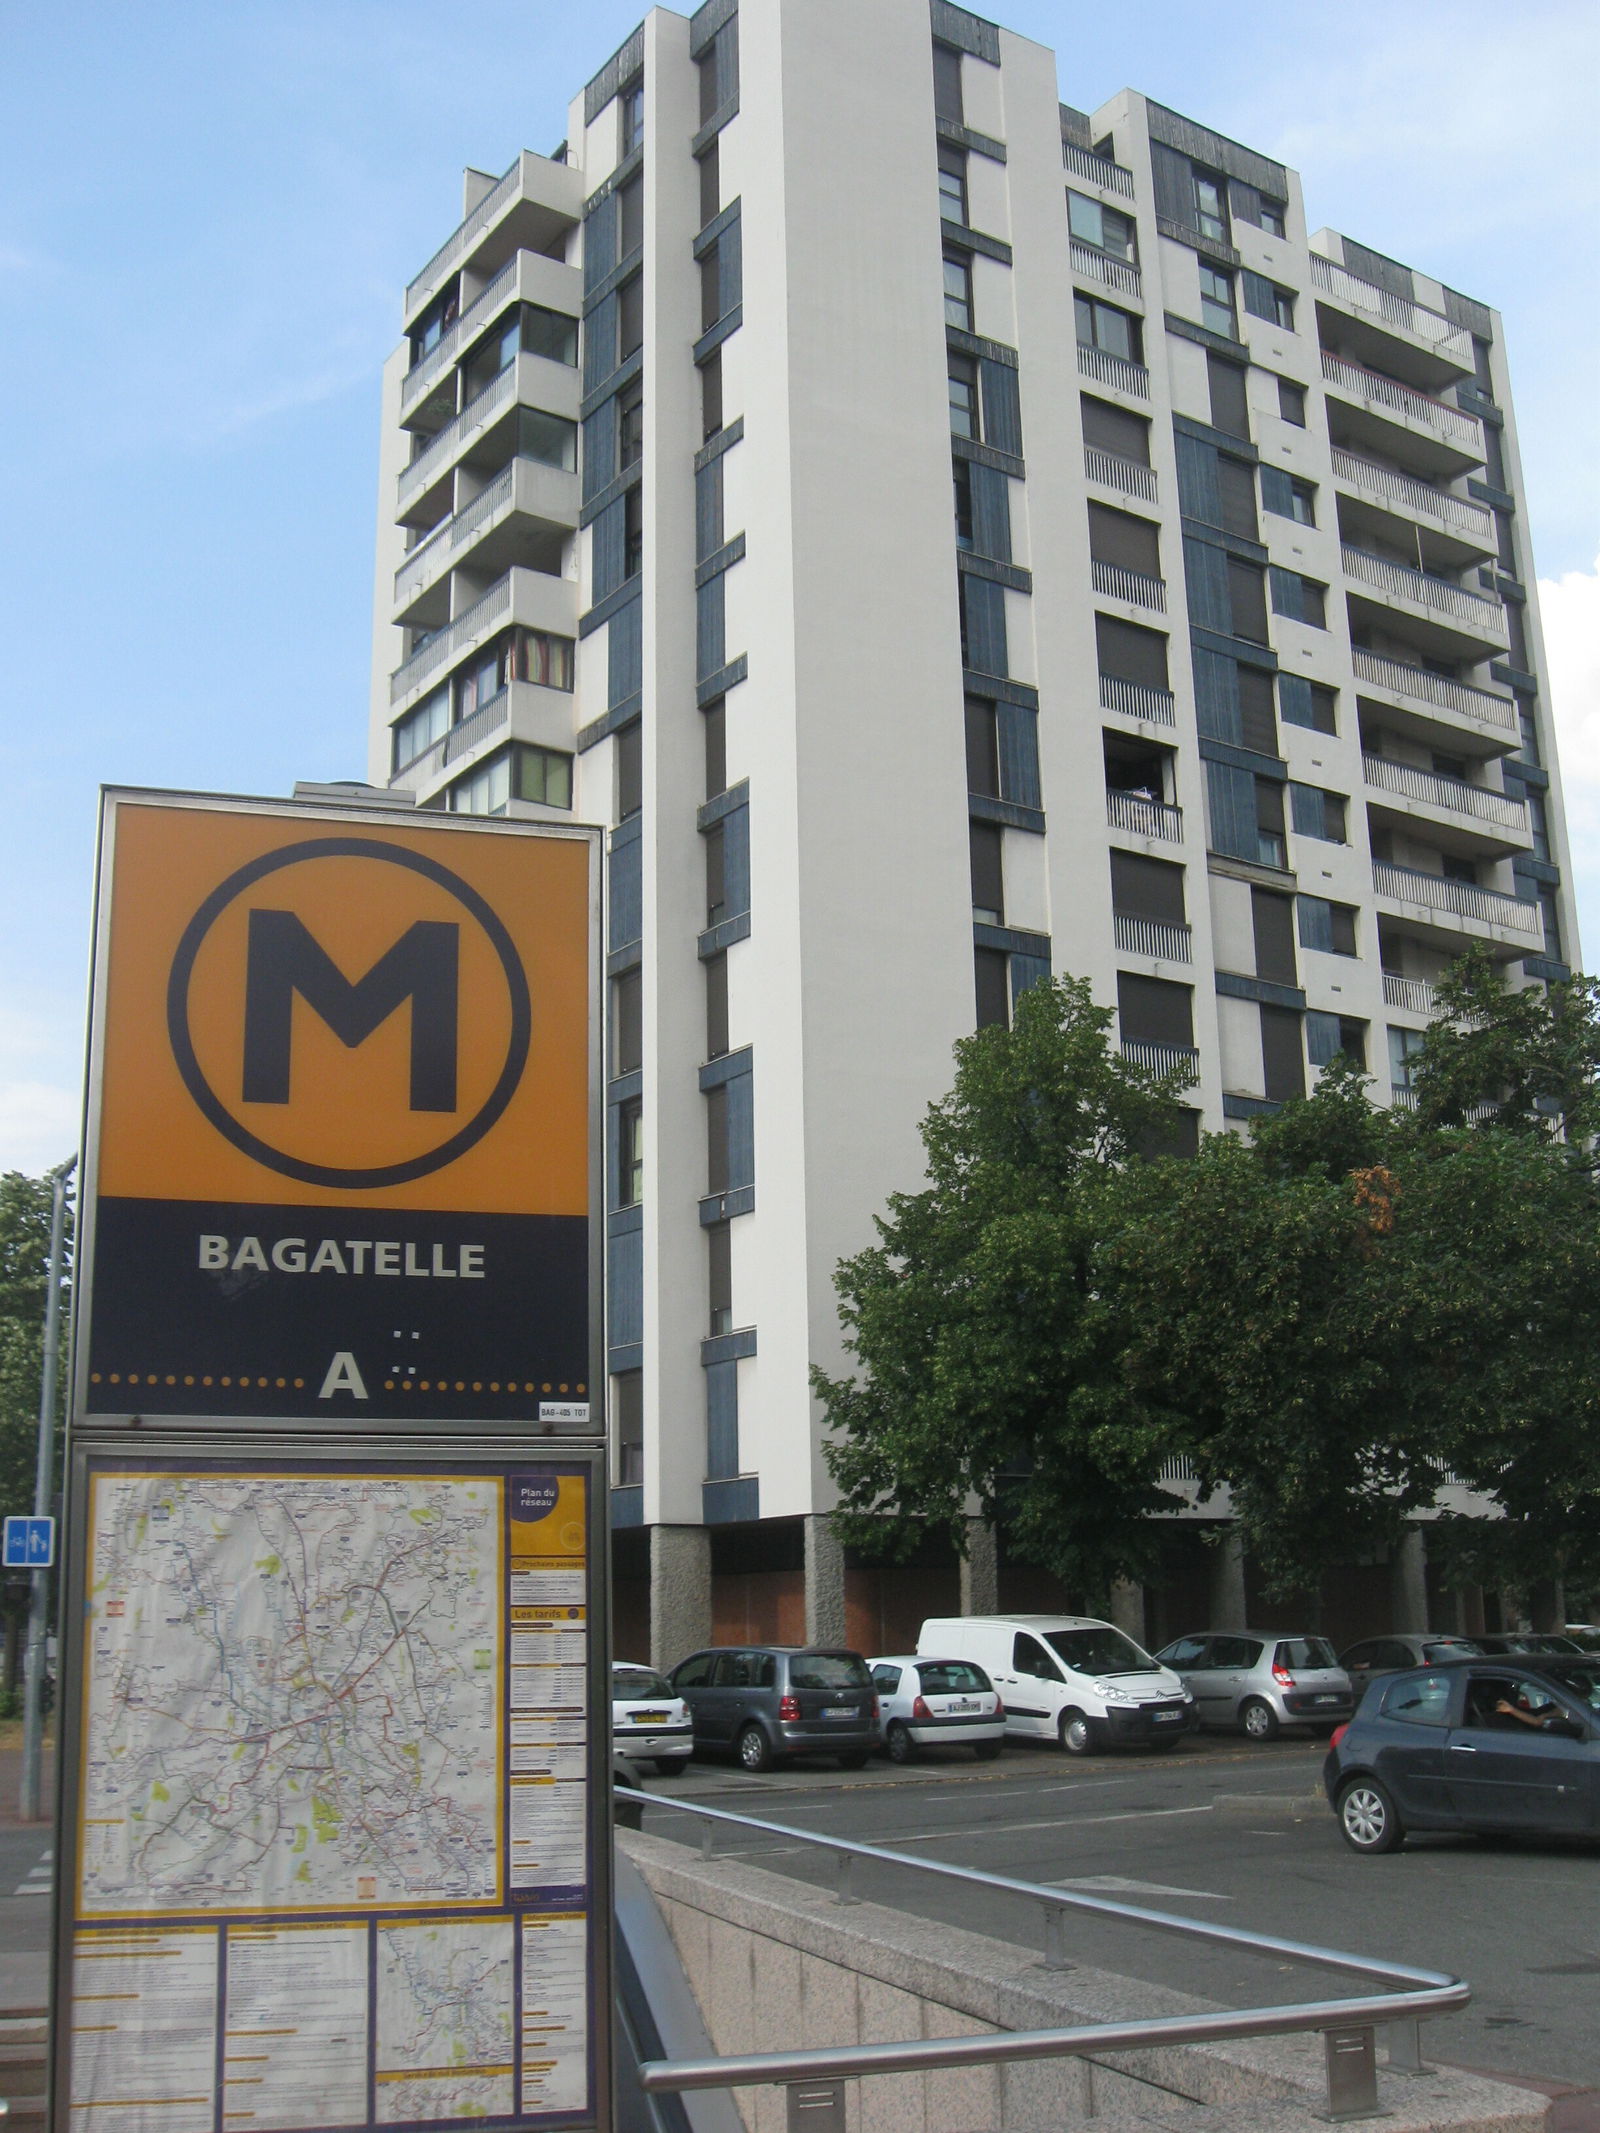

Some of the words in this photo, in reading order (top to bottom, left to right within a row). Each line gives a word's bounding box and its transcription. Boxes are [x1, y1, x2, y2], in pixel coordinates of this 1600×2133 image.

[242, 908, 459, 1113] M
[198, 1234, 486, 1278] BAGATELLE
[318, 1351, 369, 1399] A
[520, 1498, 552, 1506] réseau
[521, 1488, 541, 1497] Plan
[543, 1488, 555, 1497] du
[515, 1610, 532, 1619] Les
[535, 1609, 561, 1619] tarifs
